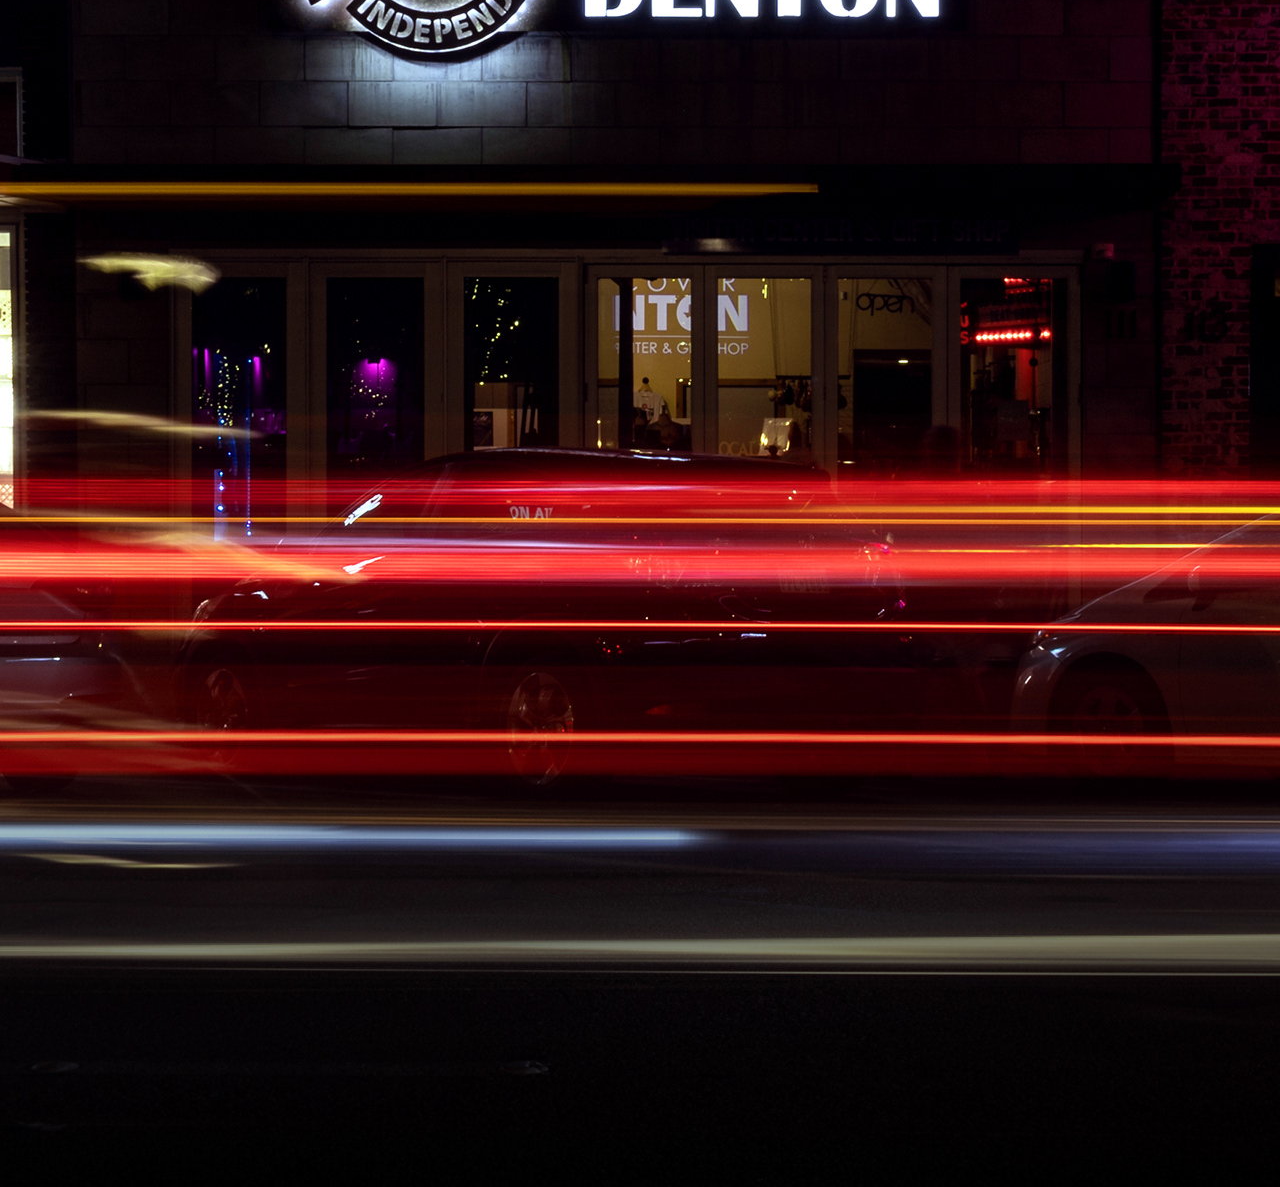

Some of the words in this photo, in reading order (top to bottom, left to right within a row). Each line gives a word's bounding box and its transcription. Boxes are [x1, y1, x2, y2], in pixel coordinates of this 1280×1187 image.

[764, 218, 855, 242] CENTER
[951, 219, 1011, 243] SHOP
[856, 292, 915, 316] open
[509, 505, 530, 520] ON
